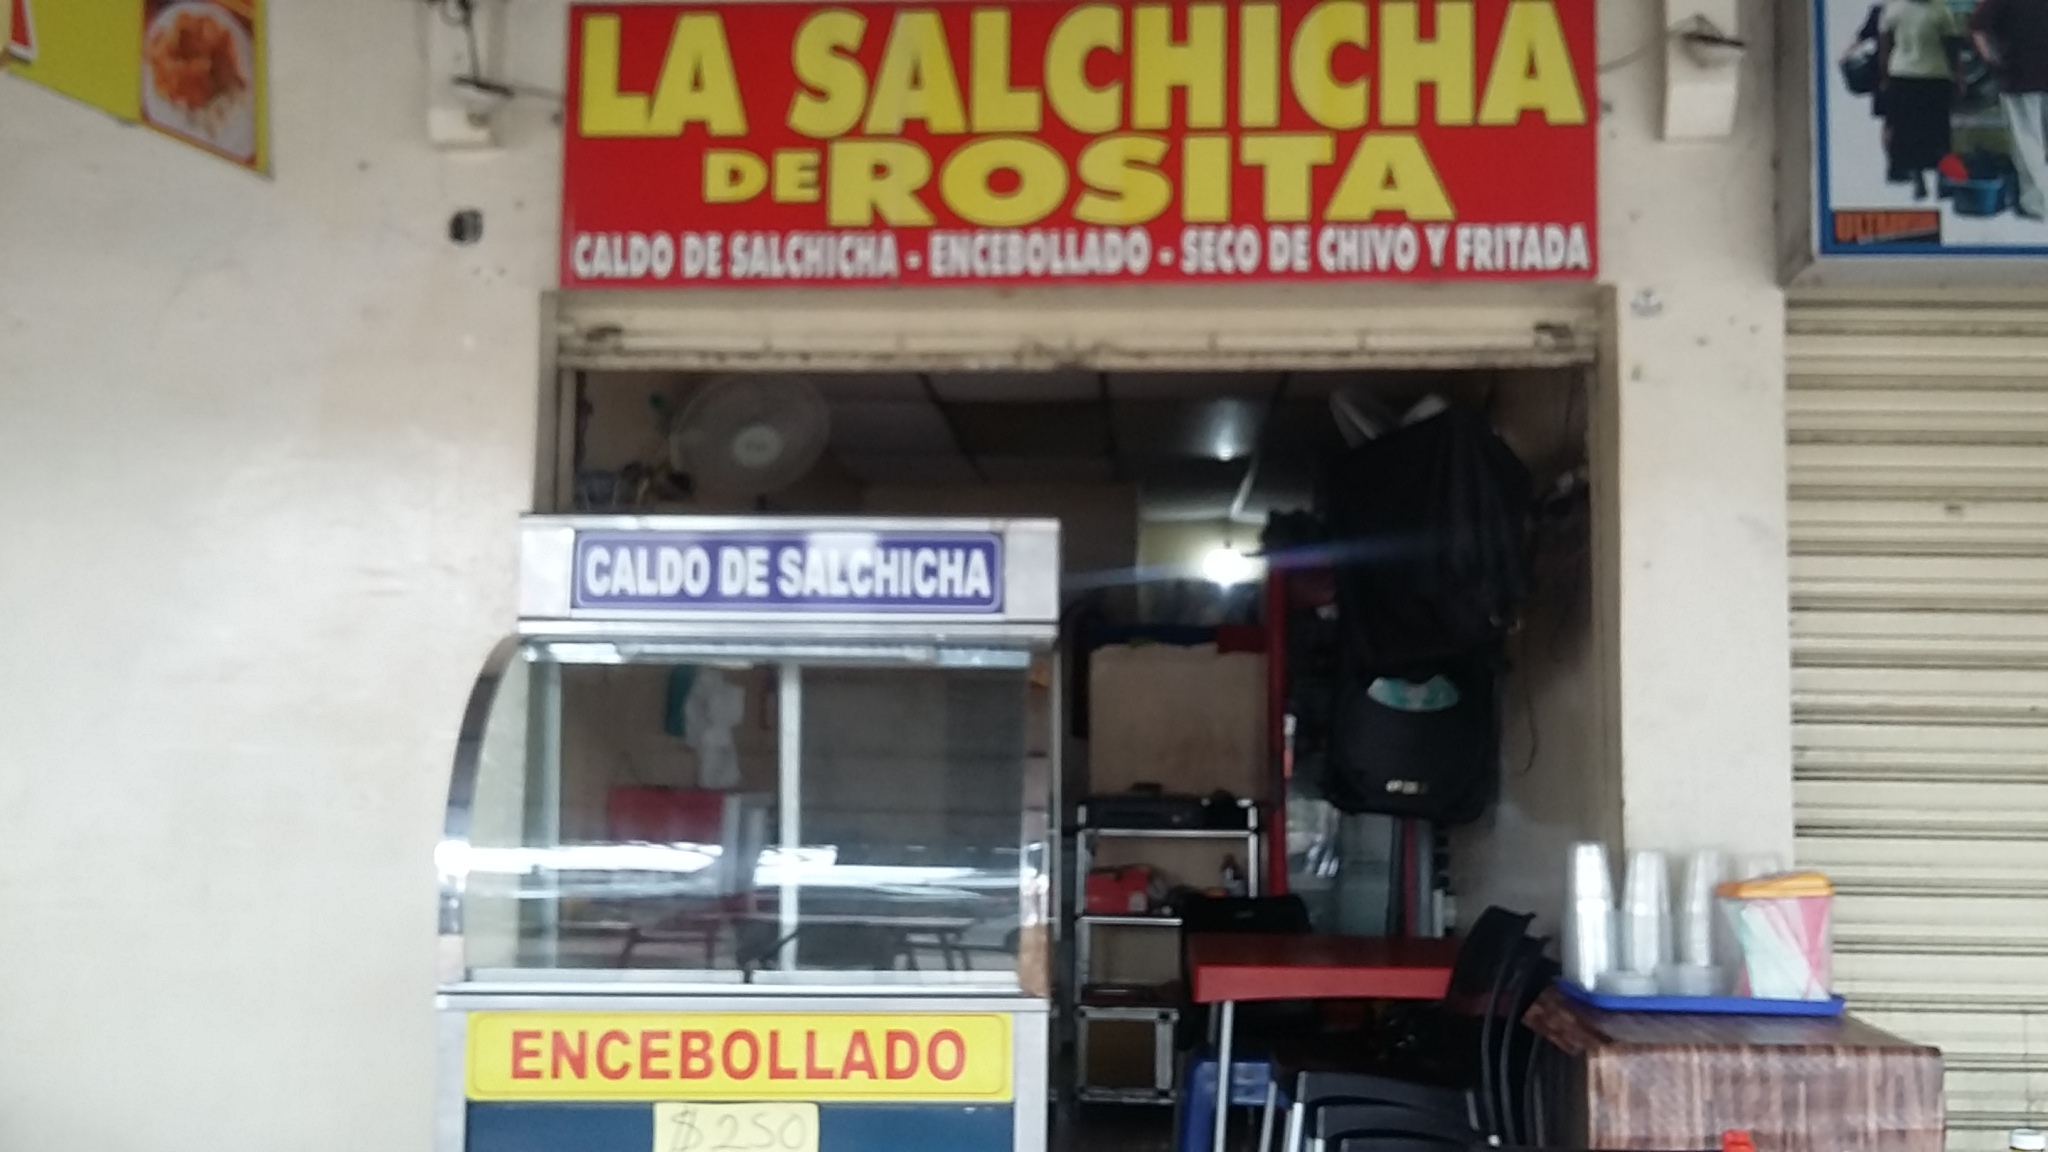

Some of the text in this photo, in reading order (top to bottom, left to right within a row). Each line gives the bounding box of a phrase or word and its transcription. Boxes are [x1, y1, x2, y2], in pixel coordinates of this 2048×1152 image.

[579, 0, 1587, 138] LA SALCHICHA
[703, 132, 1457, 227] DE ROSITA
[573, 232, 674, 279] CALDO
[682, 234, 722, 278] DE
[731, 233, 899, 278] SALCHICHA
[929, 229, 1151, 277] ENCEBOLLADO
[1180, 228, 1261, 274] SECO
[1269, 227, 1310, 272] DE
[1317, 226, 1419, 273] CHIVO
[1424, 226, 1449, 268] Y
[1456, 223, 1590, 271] FRITADA
[585, 547, 992, 598] CALDO DE SALCHICHA
[511, 1029, 966, 1081] ENCEBOLLADO
